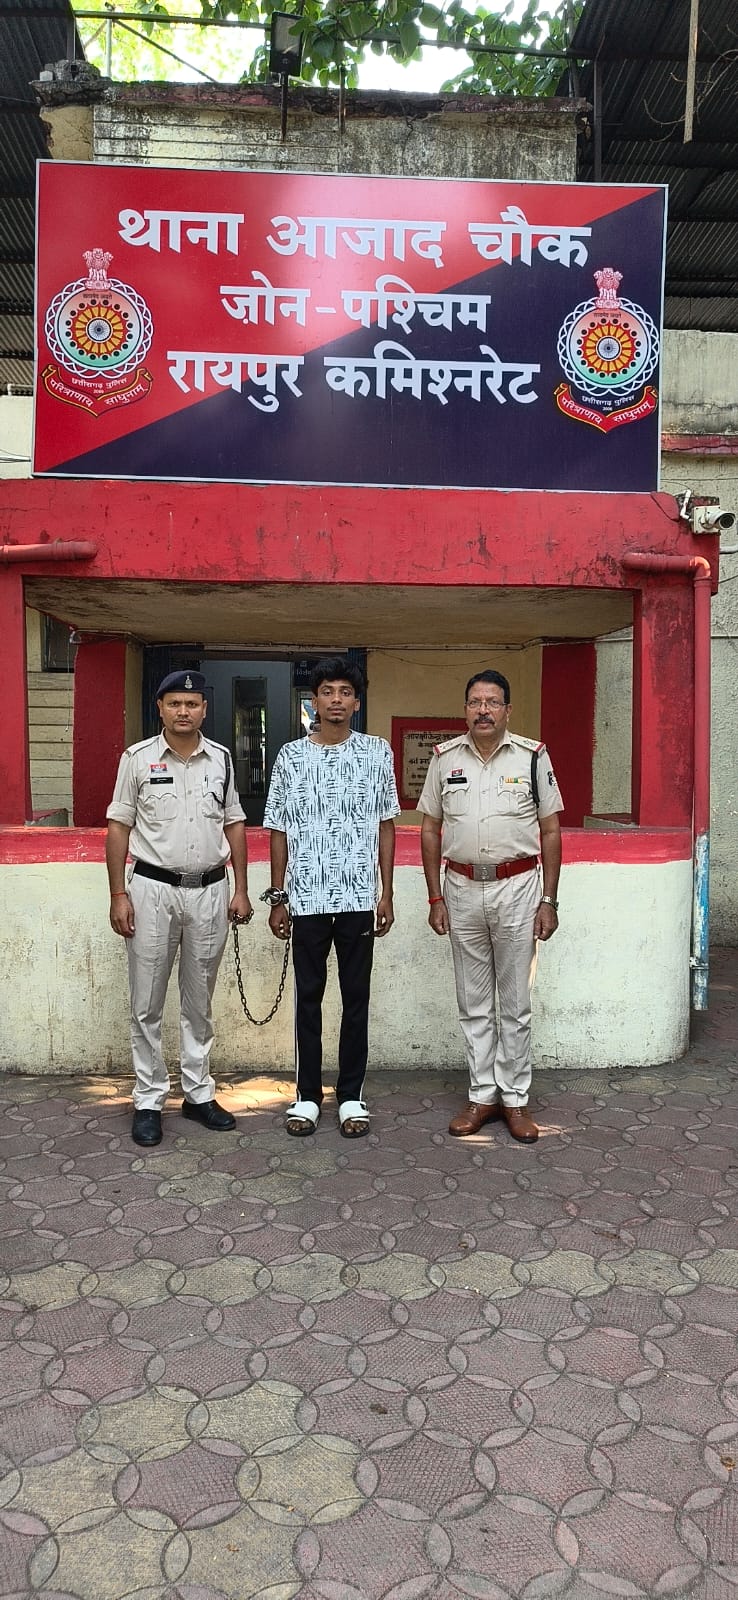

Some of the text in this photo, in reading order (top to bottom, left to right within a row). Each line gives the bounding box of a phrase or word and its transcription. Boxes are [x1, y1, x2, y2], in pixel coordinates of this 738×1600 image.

[118, 205, 592, 268] थाना आजाद चौक
[167, 340, 540, 412] रायपुर कमिश्नरेट
